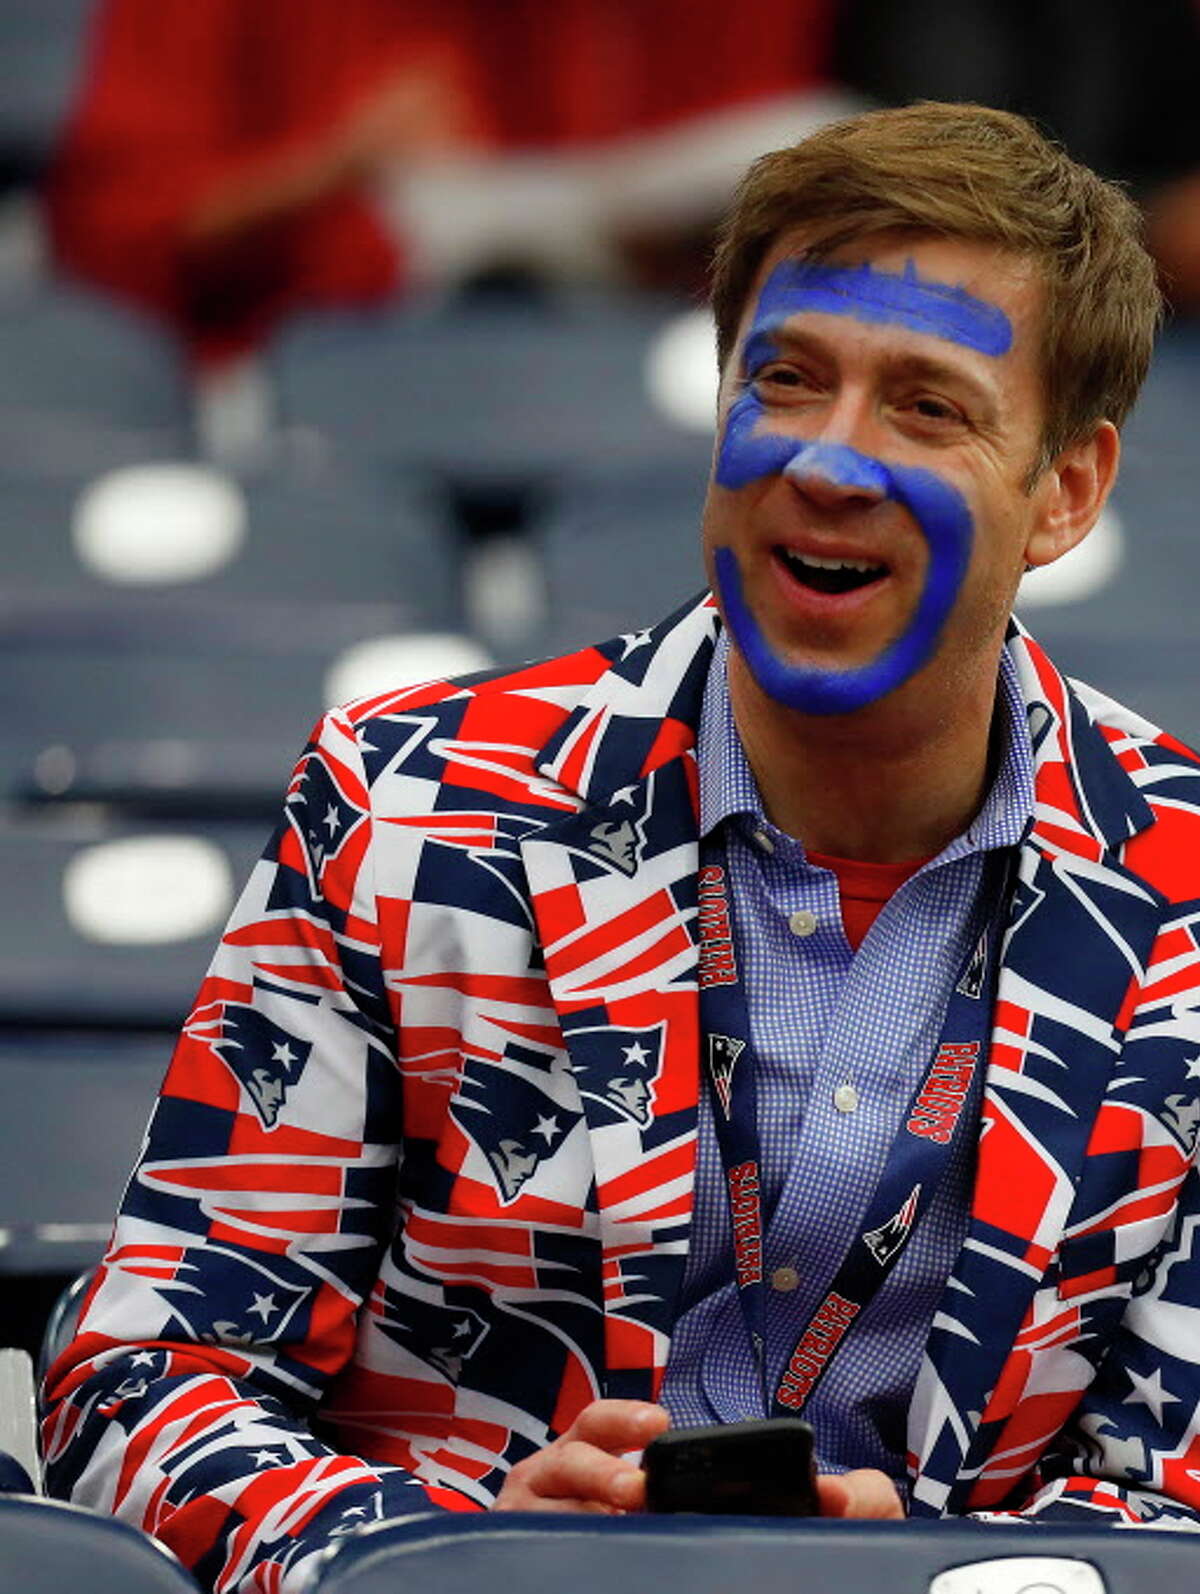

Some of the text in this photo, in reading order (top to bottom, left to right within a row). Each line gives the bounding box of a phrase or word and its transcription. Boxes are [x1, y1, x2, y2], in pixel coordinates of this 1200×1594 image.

[907, 1040, 981, 1145] PATRIOTS
[728, 1160, 762, 1289] PATRIOTS
[774, 1291, 862, 1410] PATRIOTS
